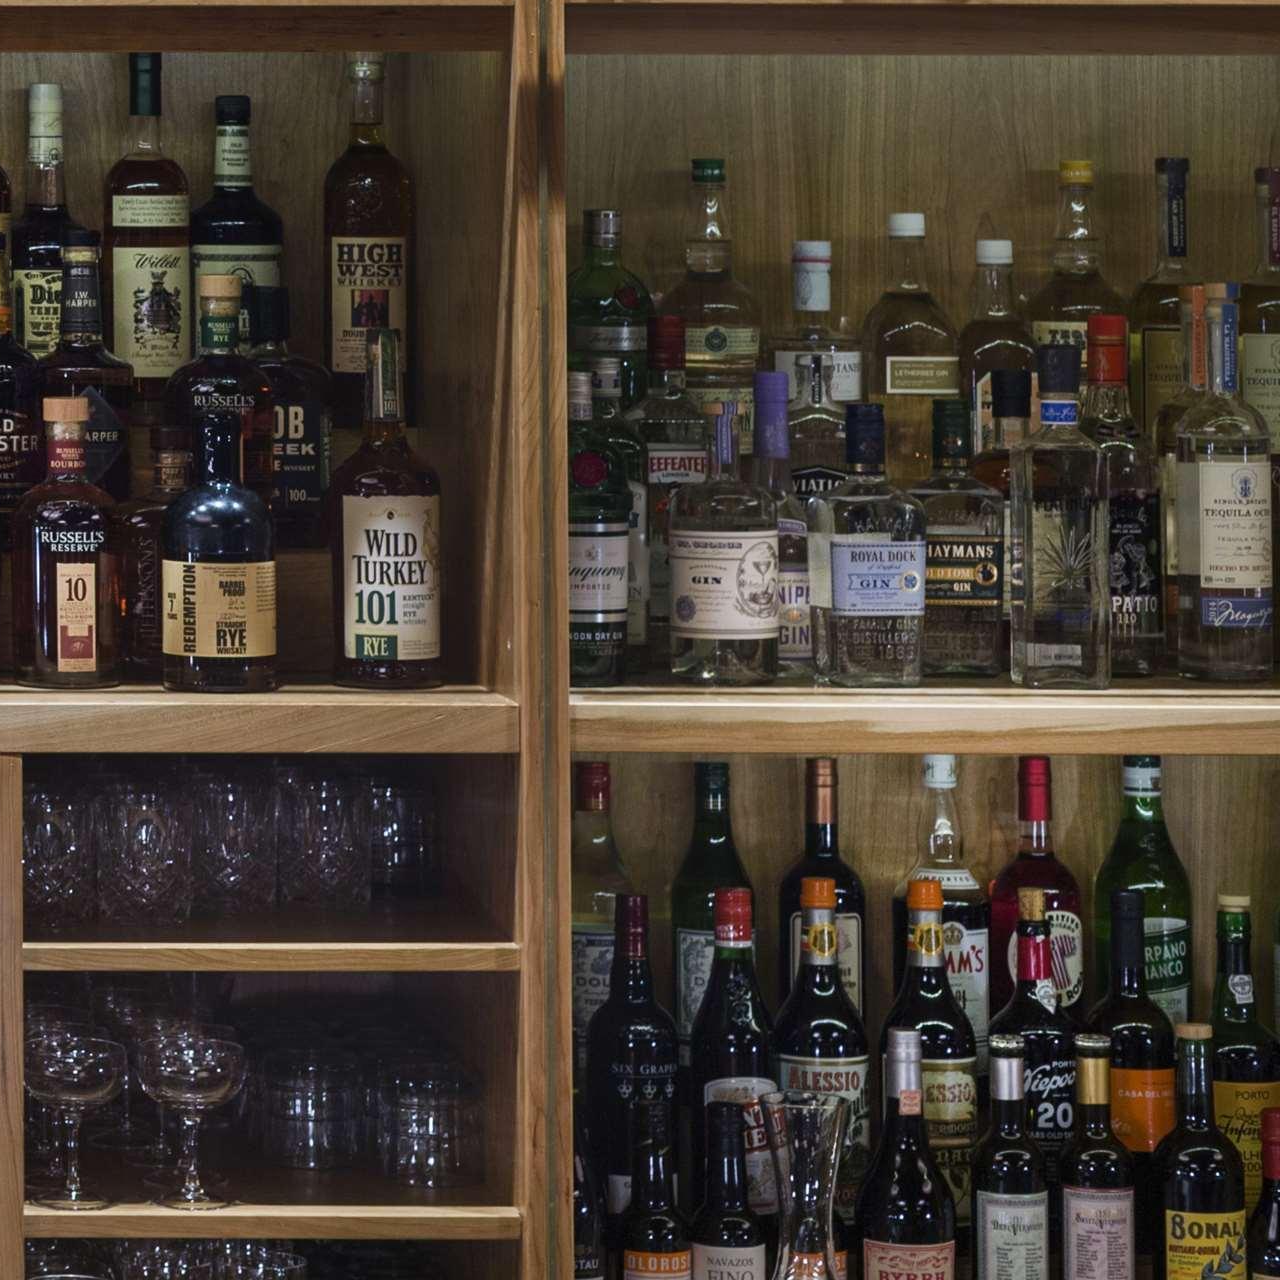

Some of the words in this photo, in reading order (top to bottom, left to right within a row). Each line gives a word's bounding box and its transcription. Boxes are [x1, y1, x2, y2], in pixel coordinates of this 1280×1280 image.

[336, 243, 402, 264] HIGH
[337, 264, 402, 278] WEST
[213, 333, 229, 342] RYE
[194, 394, 256, 408] RUSSELL'S
[272, 405, 304, 439] OB
[86, 431, 120, 441] ARPER
[273, 443, 316, 456] EEK
[289, 489, 306, 502] 100
[1203, 508, 1251, 518] TEQUILA
[41, 531, 104, 544] RUSSELL'S
[364, 529, 418, 558] WILD
[50, 544, 97, 553] RESERVE
[850, 549, 885, 563] ROYAL
[888, 548, 917, 562] DOCK
[351, 554, 428, 588] TURKEY
[691, 576, 722, 585] GIN
[859, 579, 892, 589] GIN
[65, 577, 87, 601] 10
[952, 583, 971, 593] GIN
[183, 565, 197, 653] REDEMPTION
[354, 589, 399, 626] 101
[216, 629, 247, 647] RYE
[779, 626, 810, 645] GIN
[852, 629, 917, 644] DISTILLERS
[216, 647, 247, 656] WHISKEY
[363, 636, 389, 657] RYE
[1145, 960, 1183, 980] IANCO
[574, 976, 610, 988] DOL
[611, 1063, 633, 1074] SIX
[788, 1068, 861, 1094] ALESSIO
[1235, 1090, 1269, 1100] PORTO
[1037, 1101, 1074, 1129] 20
[1171, 1214, 1240, 1240] BONAL
[627, 1255, 688, 1272] OLOROS
[707, 1256, 754, 1267] NAVAZOS
